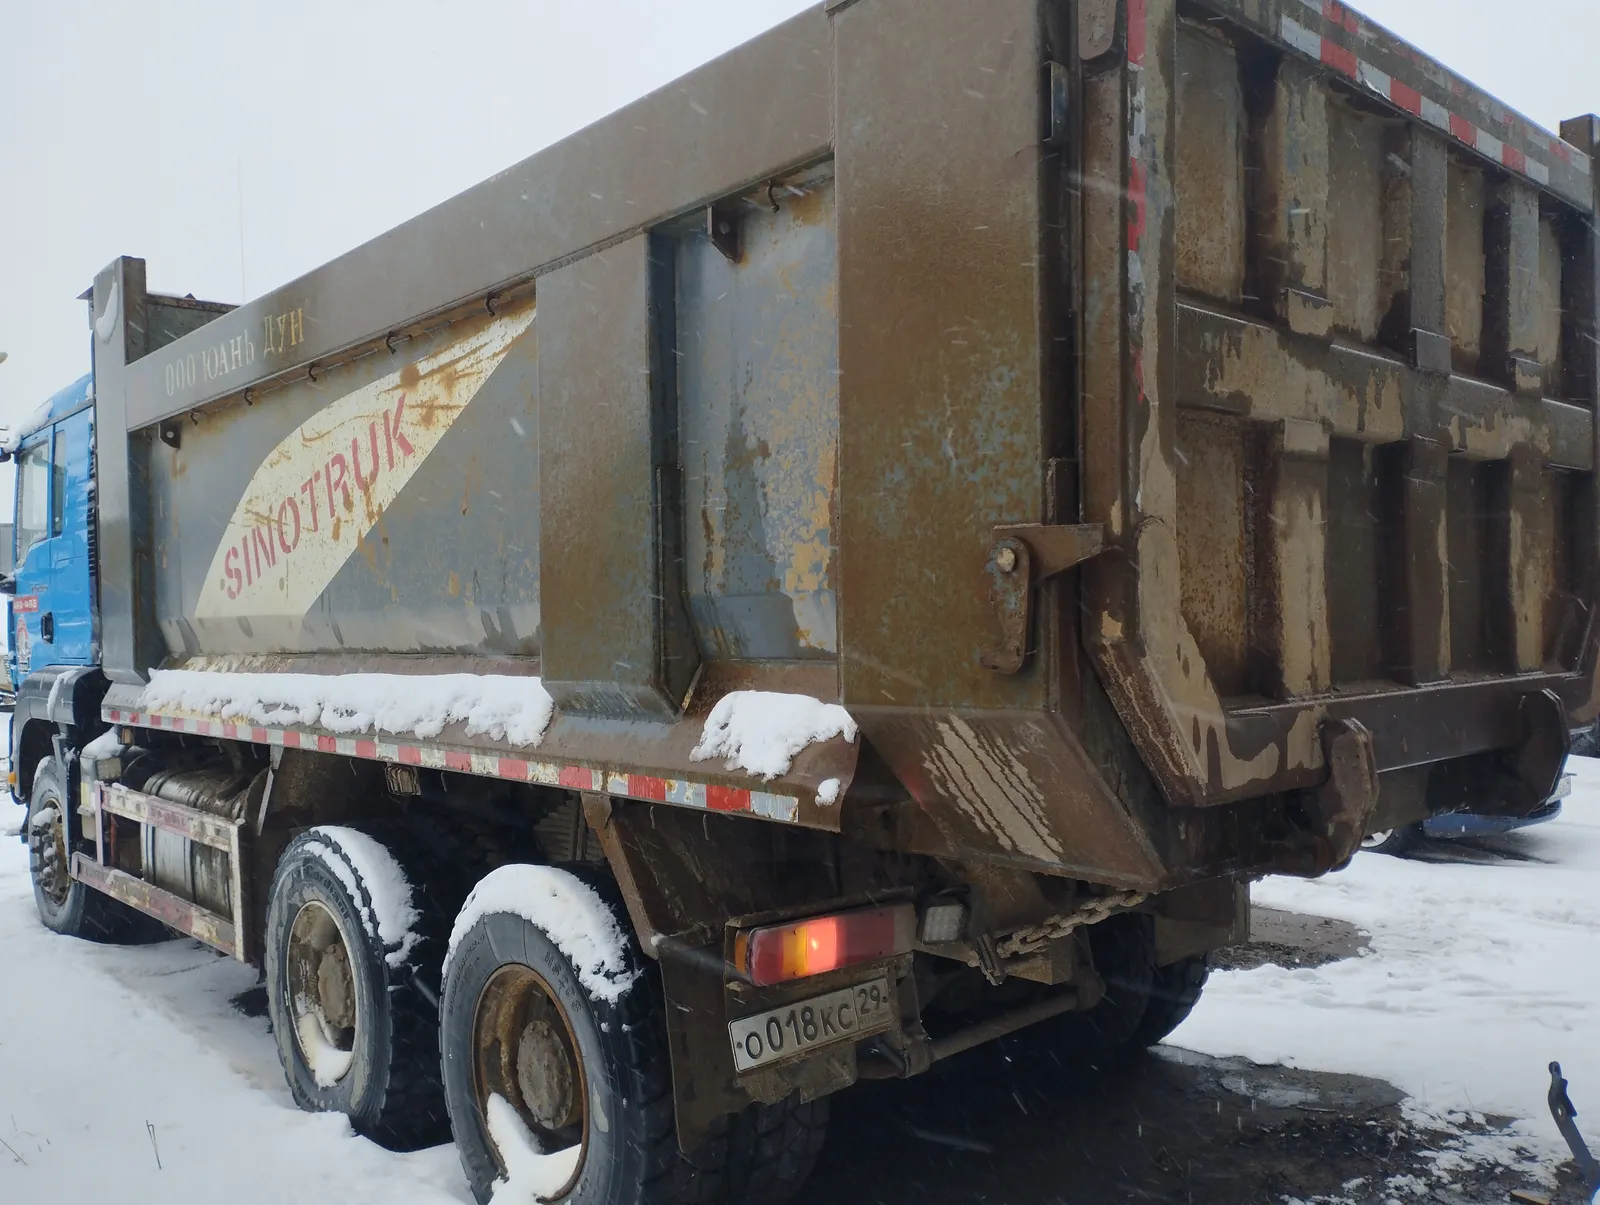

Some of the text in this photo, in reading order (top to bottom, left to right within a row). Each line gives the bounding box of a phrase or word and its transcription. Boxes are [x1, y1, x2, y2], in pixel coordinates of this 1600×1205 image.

[202, 329, 255, 382] ЮАНЬ
[263, 307, 305, 359] ДУН
[224, 391, 415, 600] SINOTRUK
